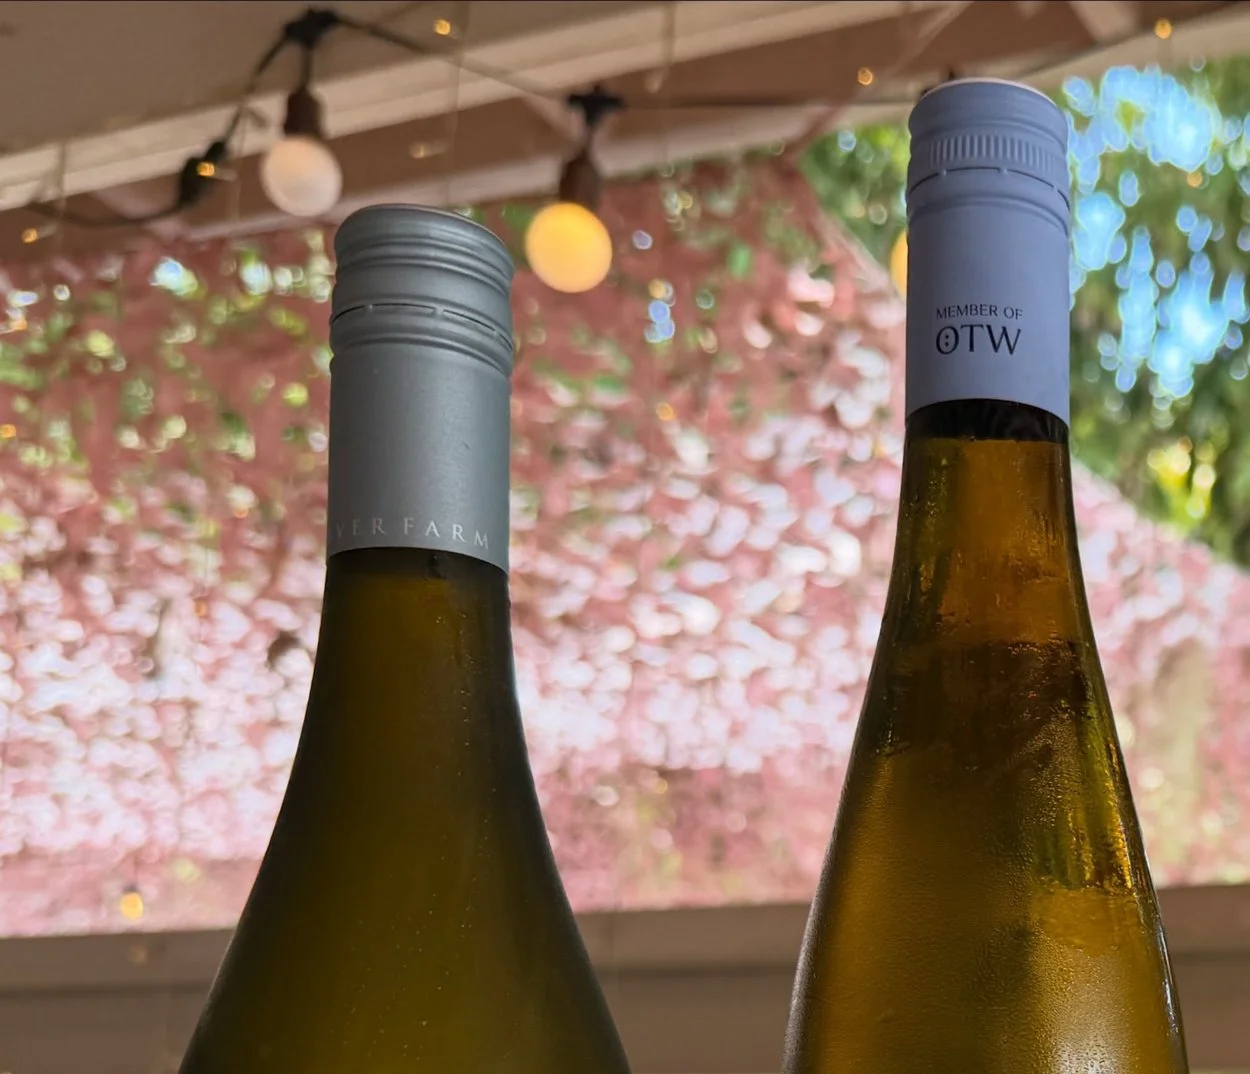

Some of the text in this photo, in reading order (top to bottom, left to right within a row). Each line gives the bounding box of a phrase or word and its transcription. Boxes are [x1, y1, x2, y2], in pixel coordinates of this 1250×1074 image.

[936, 304, 1024, 320] MEMBER OF
[336, 517, 489, 550] VER FARM
